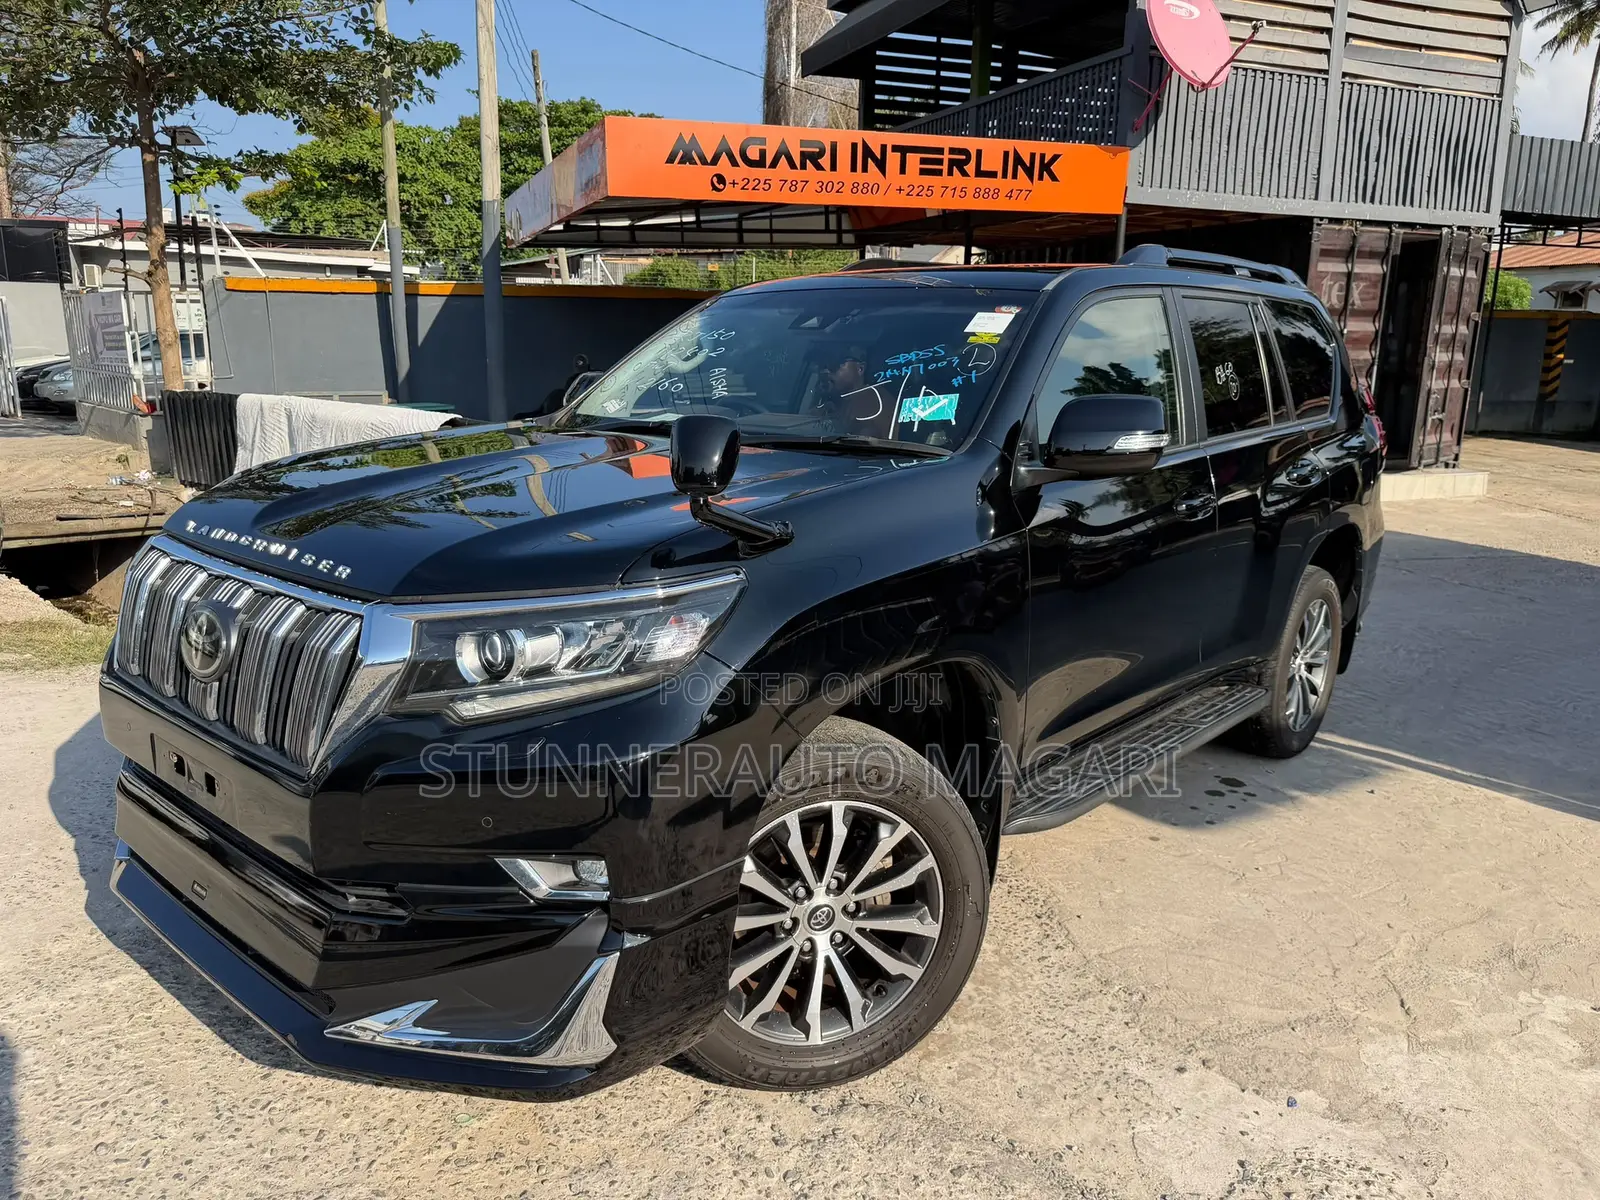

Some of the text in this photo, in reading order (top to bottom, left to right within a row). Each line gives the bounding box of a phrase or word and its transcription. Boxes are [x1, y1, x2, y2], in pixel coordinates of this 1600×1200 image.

[665, 132, 1063, 186] MAGARI INTERLINK
[729, 177, 772, 192] +225
[779, 179, 810, 194] 787
[814, 180, 845, 194] 302
[850, 181, 881, 196] 880
[896, 184, 935, 198] +225
[940, 185, 968, 199] 715
[973, 187, 1001, 200] 888
[1004, 188, 1033, 201] 477
